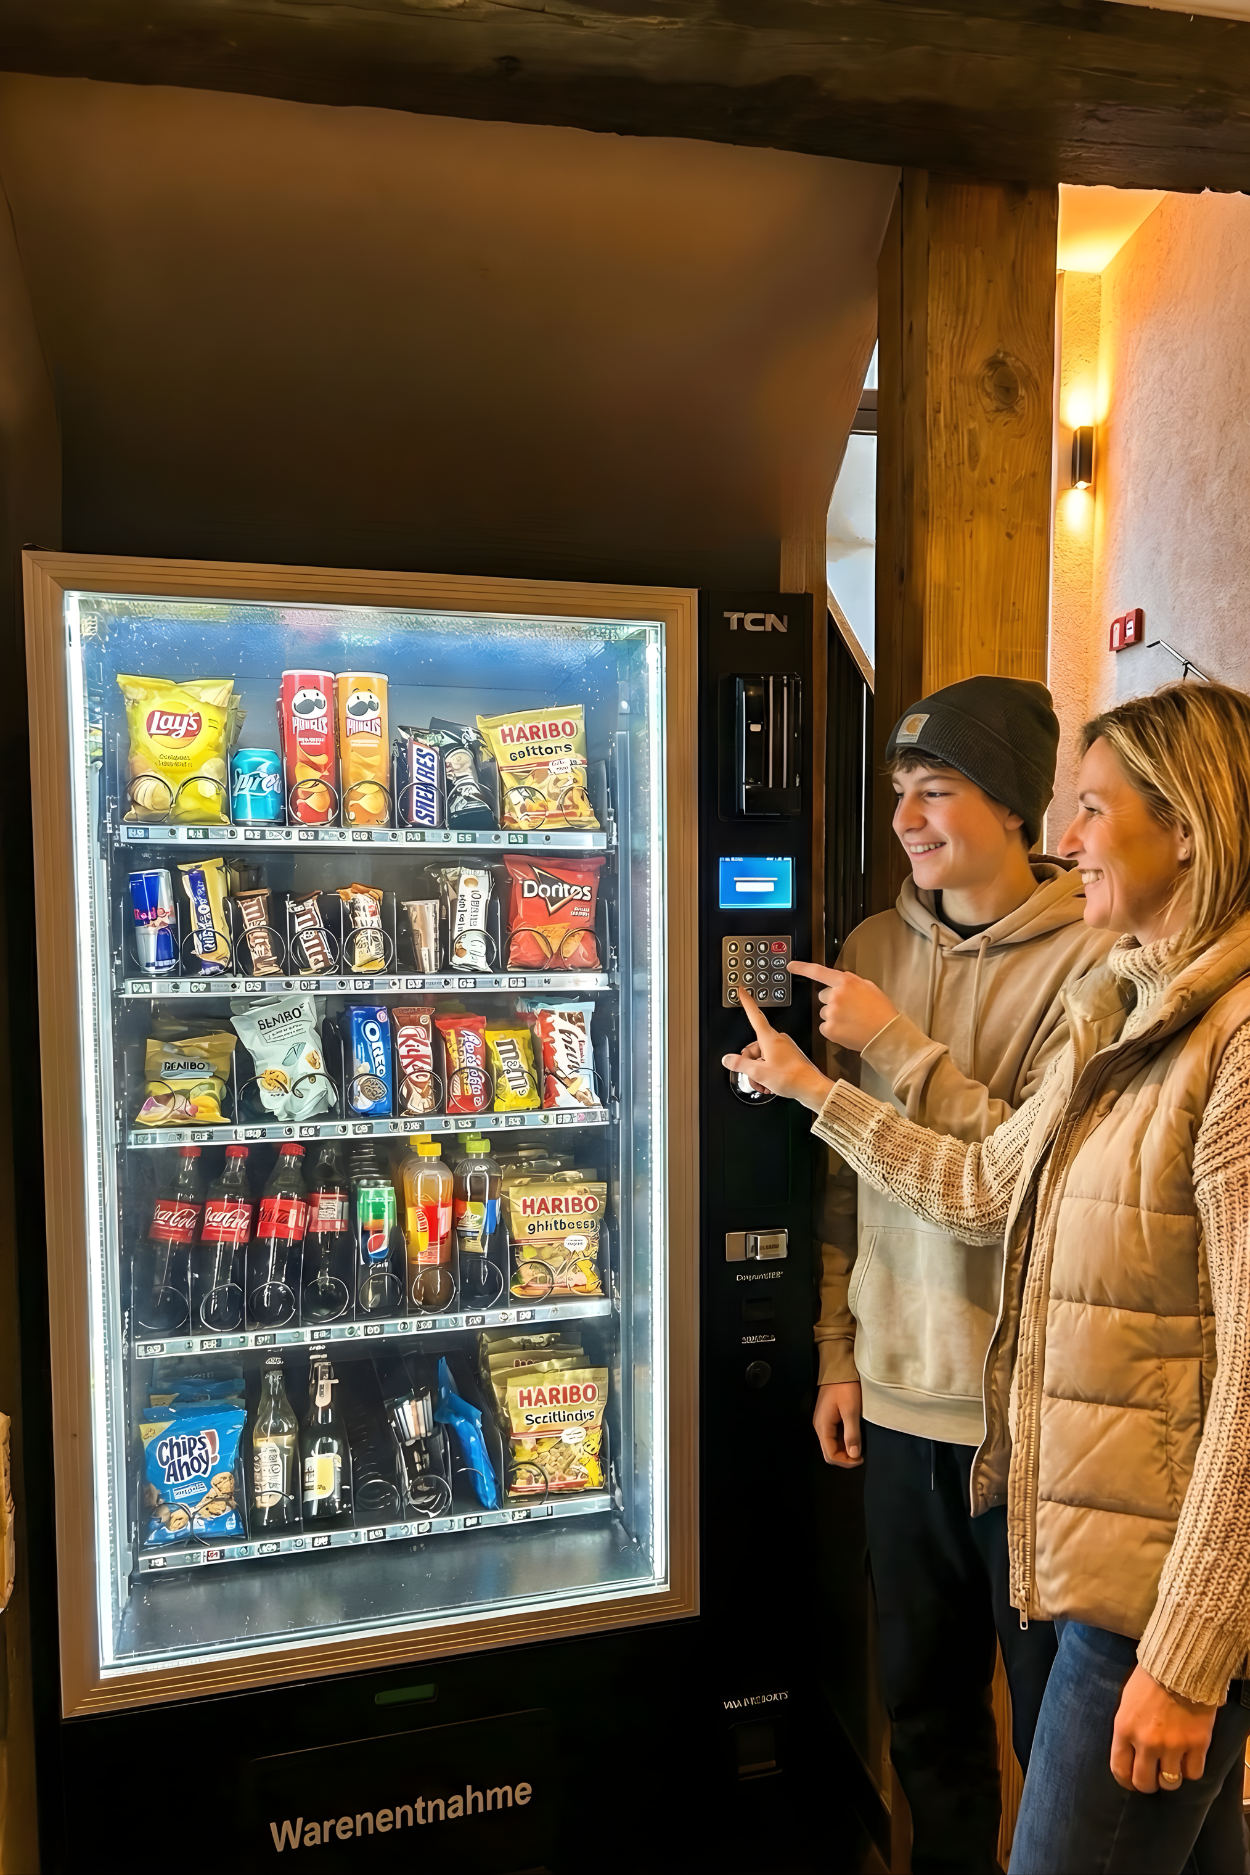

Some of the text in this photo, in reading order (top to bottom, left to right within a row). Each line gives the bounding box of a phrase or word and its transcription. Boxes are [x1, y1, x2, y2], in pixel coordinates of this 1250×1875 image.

[723, 611, 788, 632] TCN
[149, 711, 200, 739] Lay's
[500, 720, 575, 744] HARIBO
[523, 880, 592, 901] Doritos
[522, 1195, 599, 1215] HARIBO
[518, 1383, 597, 1408] HARIBO
[157, 1435, 208, 1467] Chips
[269, 1781, 533, 1853] Warenentnahme
